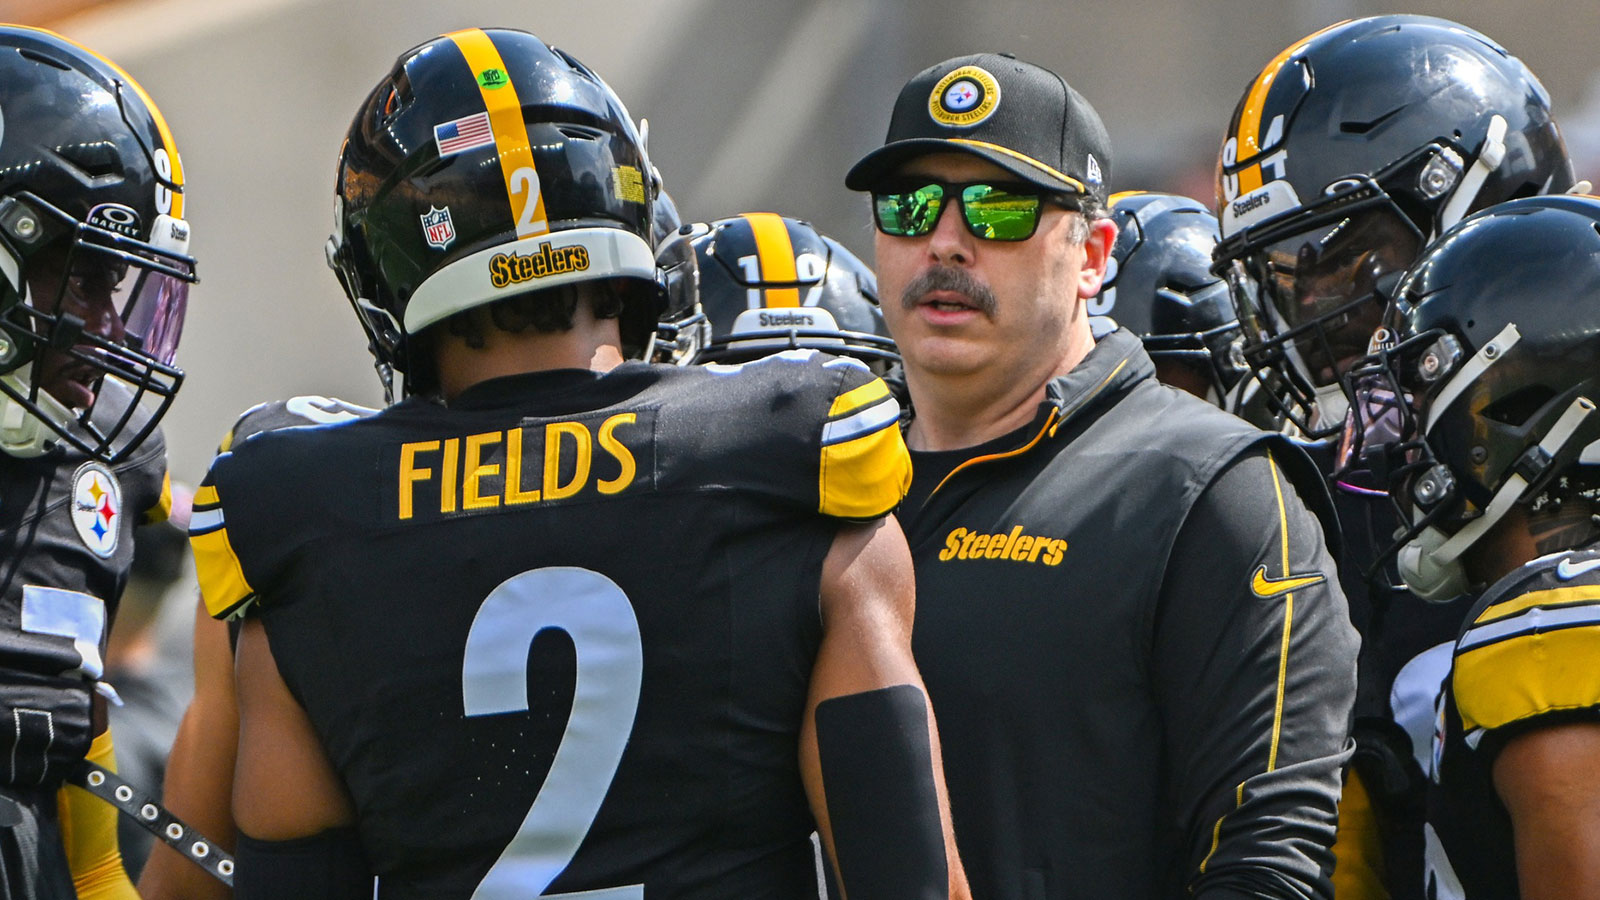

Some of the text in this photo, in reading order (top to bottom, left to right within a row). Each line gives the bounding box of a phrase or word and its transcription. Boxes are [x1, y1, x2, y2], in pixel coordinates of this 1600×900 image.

[932, 100, 992, 121] PITTSBURGH STEELERS
[510, 166, 547, 238] 2
[1232, 191, 1271, 219] Steelers
[90, 216, 140, 236] OAKLEY
[426, 221, 452, 243] NFL
[488, 241, 590, 289] Steelers
[759, 310, 814, 327] Steelers
[398, 412, 637, 520] FIELDS
[938, 524, 1068, 567] Steelers
[462, 565, 645, 900] 2
